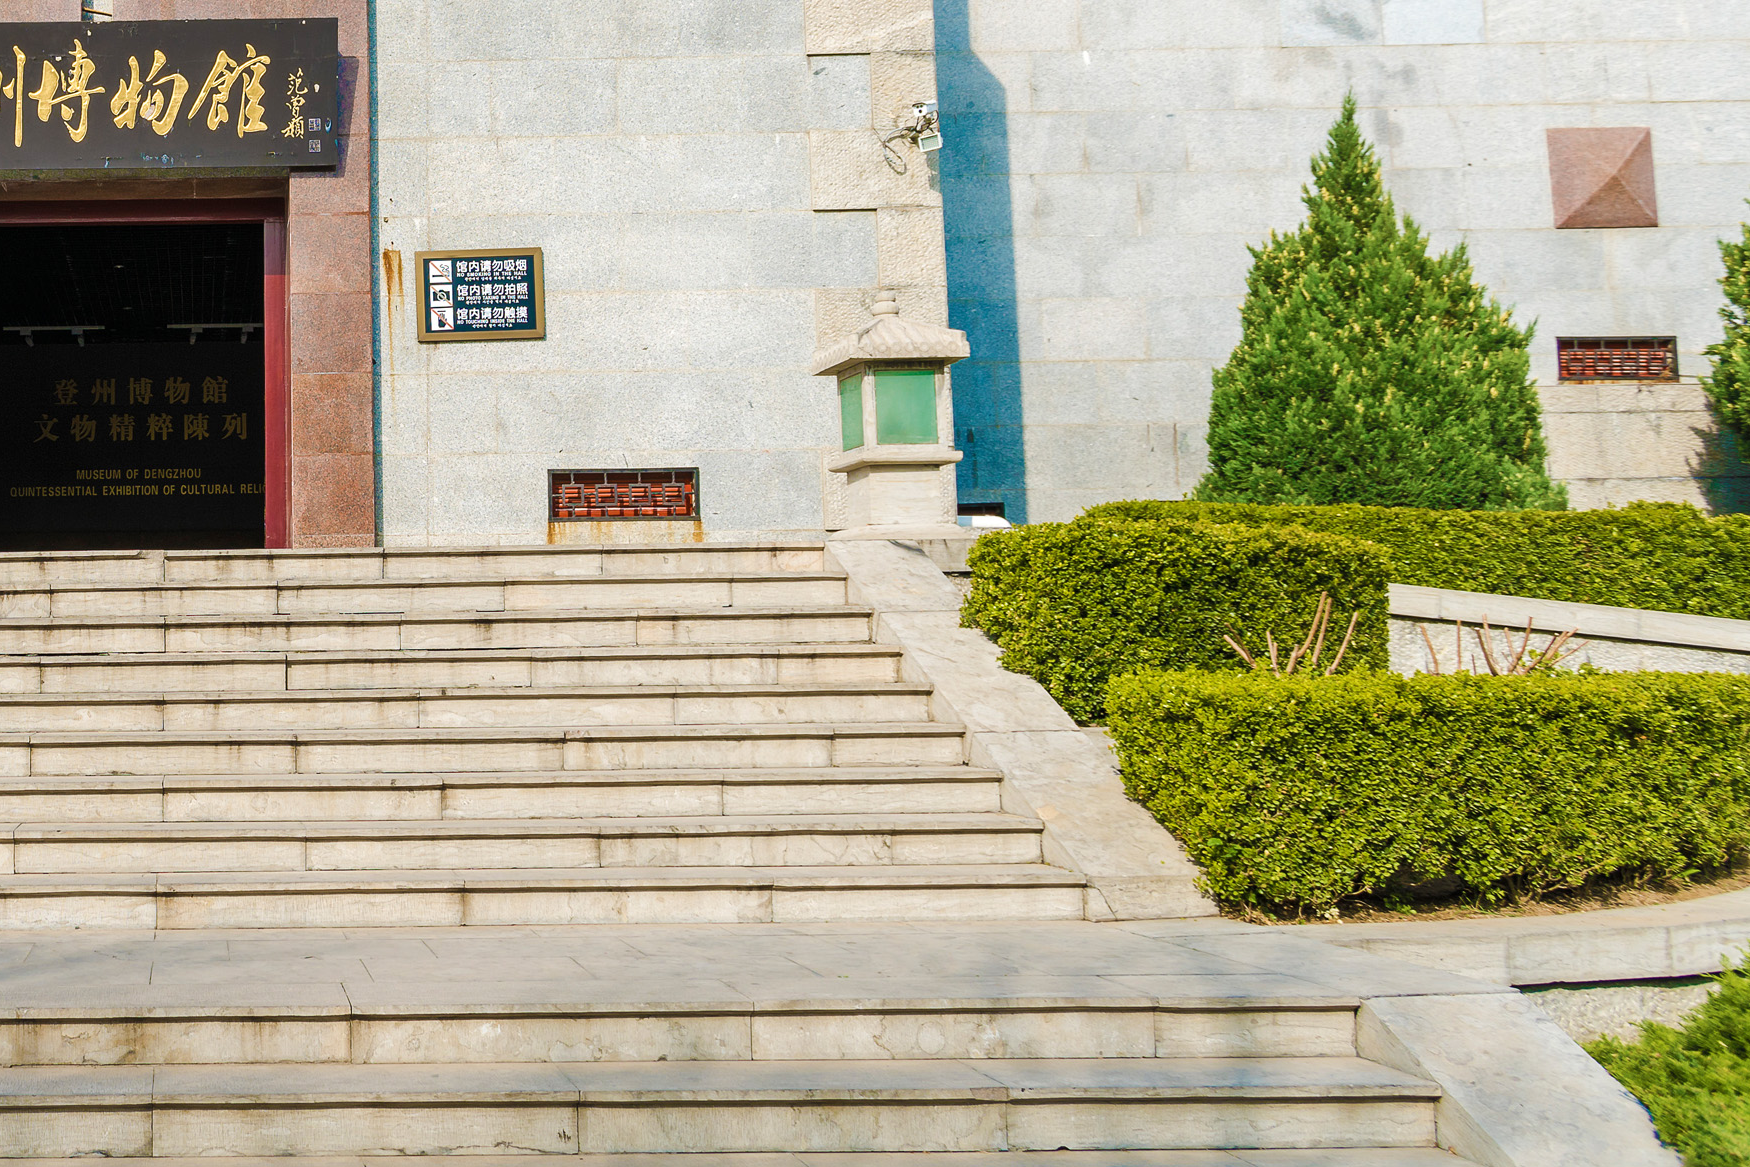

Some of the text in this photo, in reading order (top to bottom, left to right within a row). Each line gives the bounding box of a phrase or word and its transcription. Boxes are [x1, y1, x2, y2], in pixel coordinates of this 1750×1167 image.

[456, 259, 527, 272] 馆内请勿吸烟
[457, 282, 528, 296] 馆内请勿拍照
[456, 306, 528, 320] 馆内请勿触摸
[53, 375, 230, 406] 登州博物館
[33, 412, 248, 443] 文物精粹陳列
[76, 468, 201, 480] MUSEUM OF DENGZHOU
[10, 486, 98, 497] QUINTESSENTIAL
[102, 485, 159, 496] EXHIBITION
[163, 485, 176, 496] OF
[180, 484, 235, 495] CULTURAL
